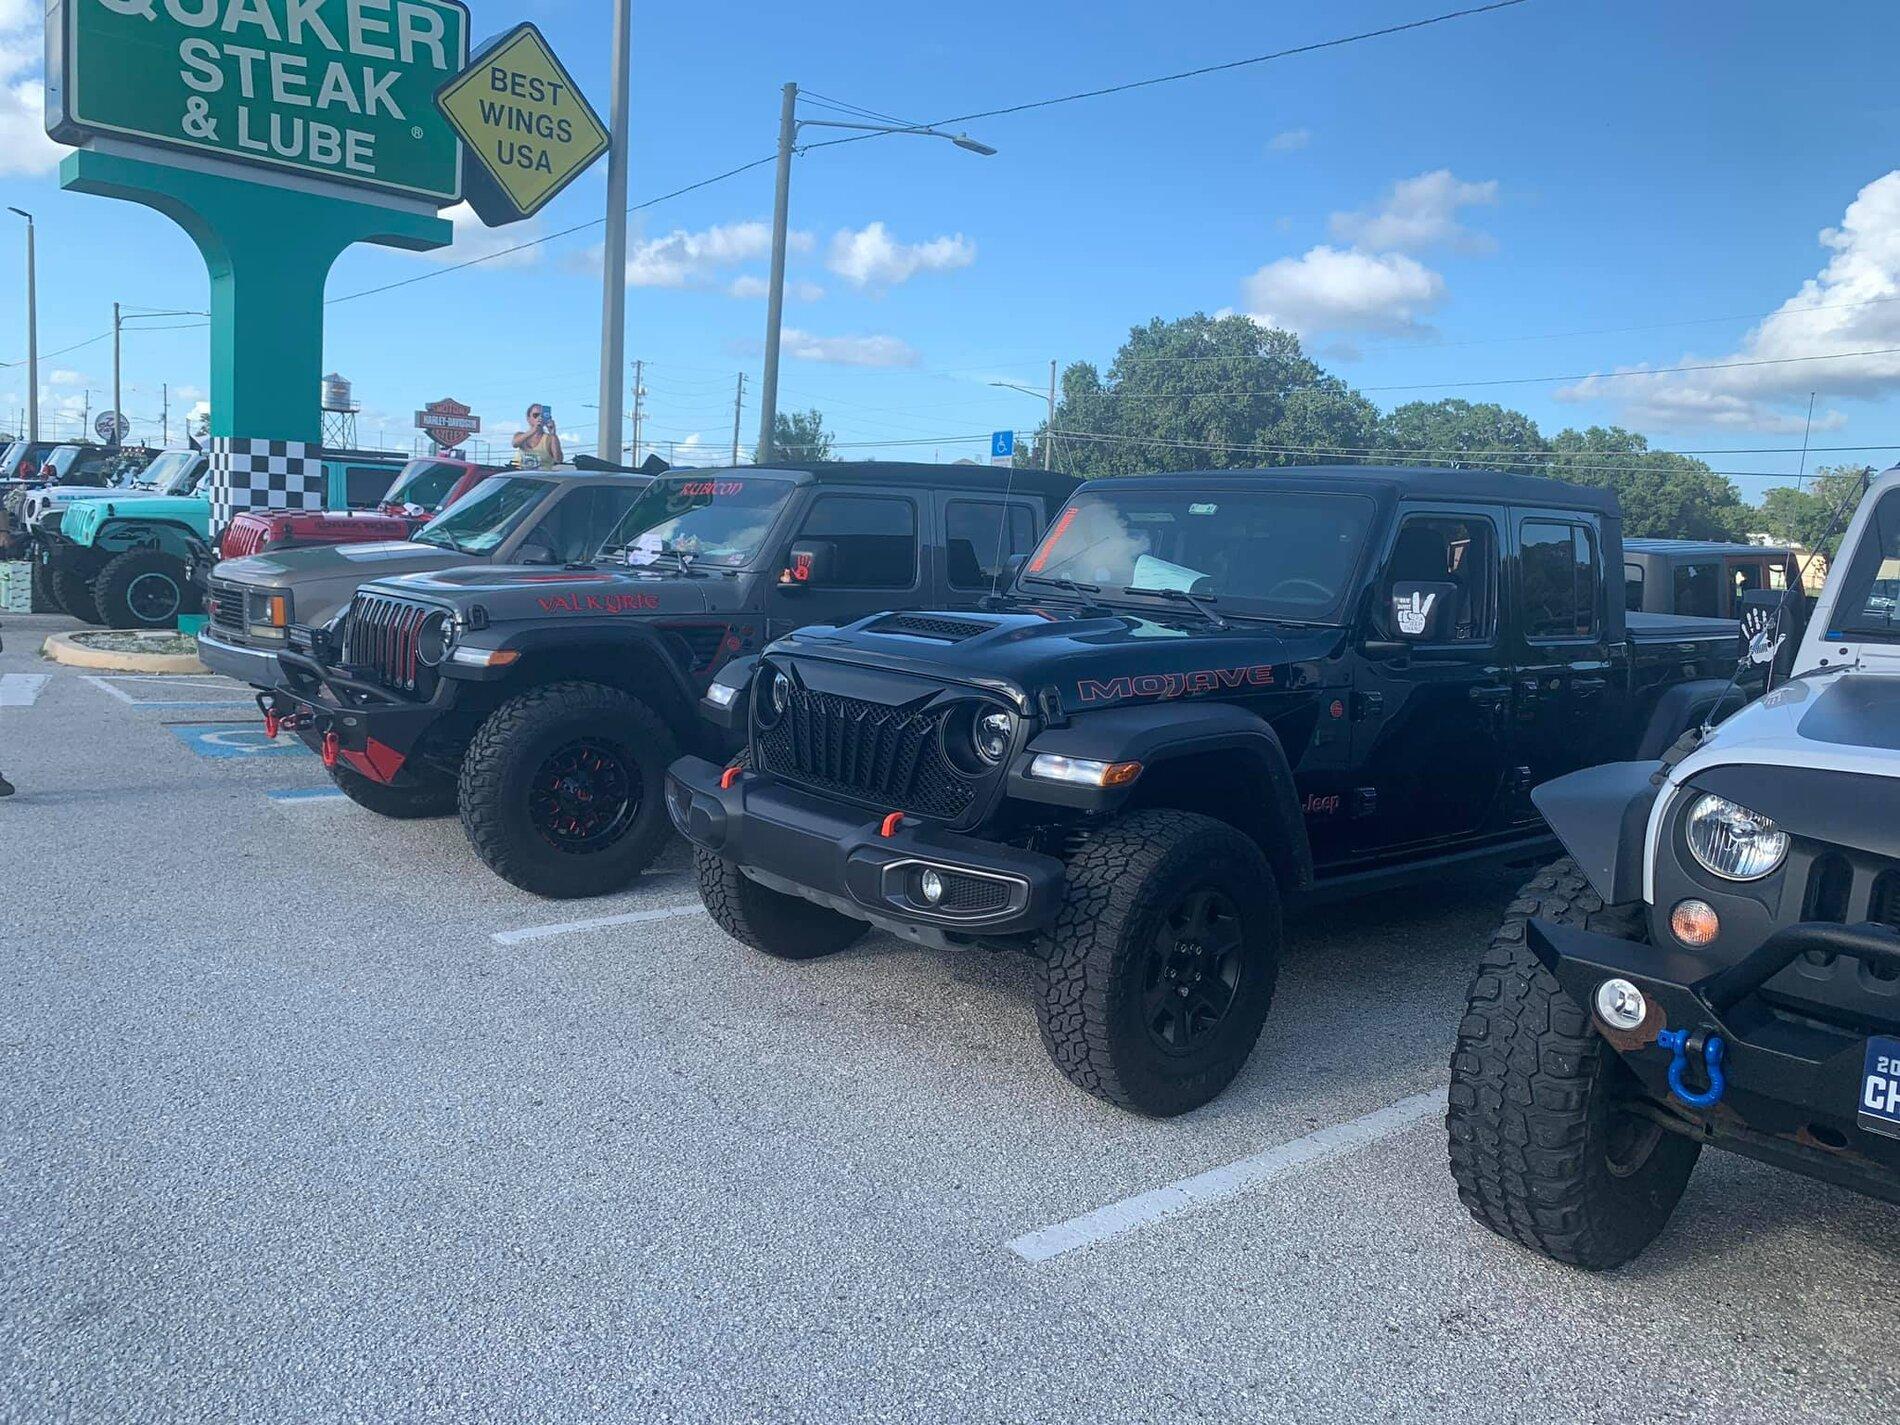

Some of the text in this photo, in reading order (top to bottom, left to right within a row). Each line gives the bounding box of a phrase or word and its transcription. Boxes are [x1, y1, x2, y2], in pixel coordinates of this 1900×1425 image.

[98, 0, 448, 70] AKER
[179, 37, 407, 121] STEAK
[490, 66, 564, 106] BEST
[182, 95, 377, 174] & LUBE
[478, 99, 573, 143] WINGS
[497, 139, 553, 175] USA
[1077, 664, 1275, 701] MOJAVE
[1301, 793, 1339, 815] Jeep
